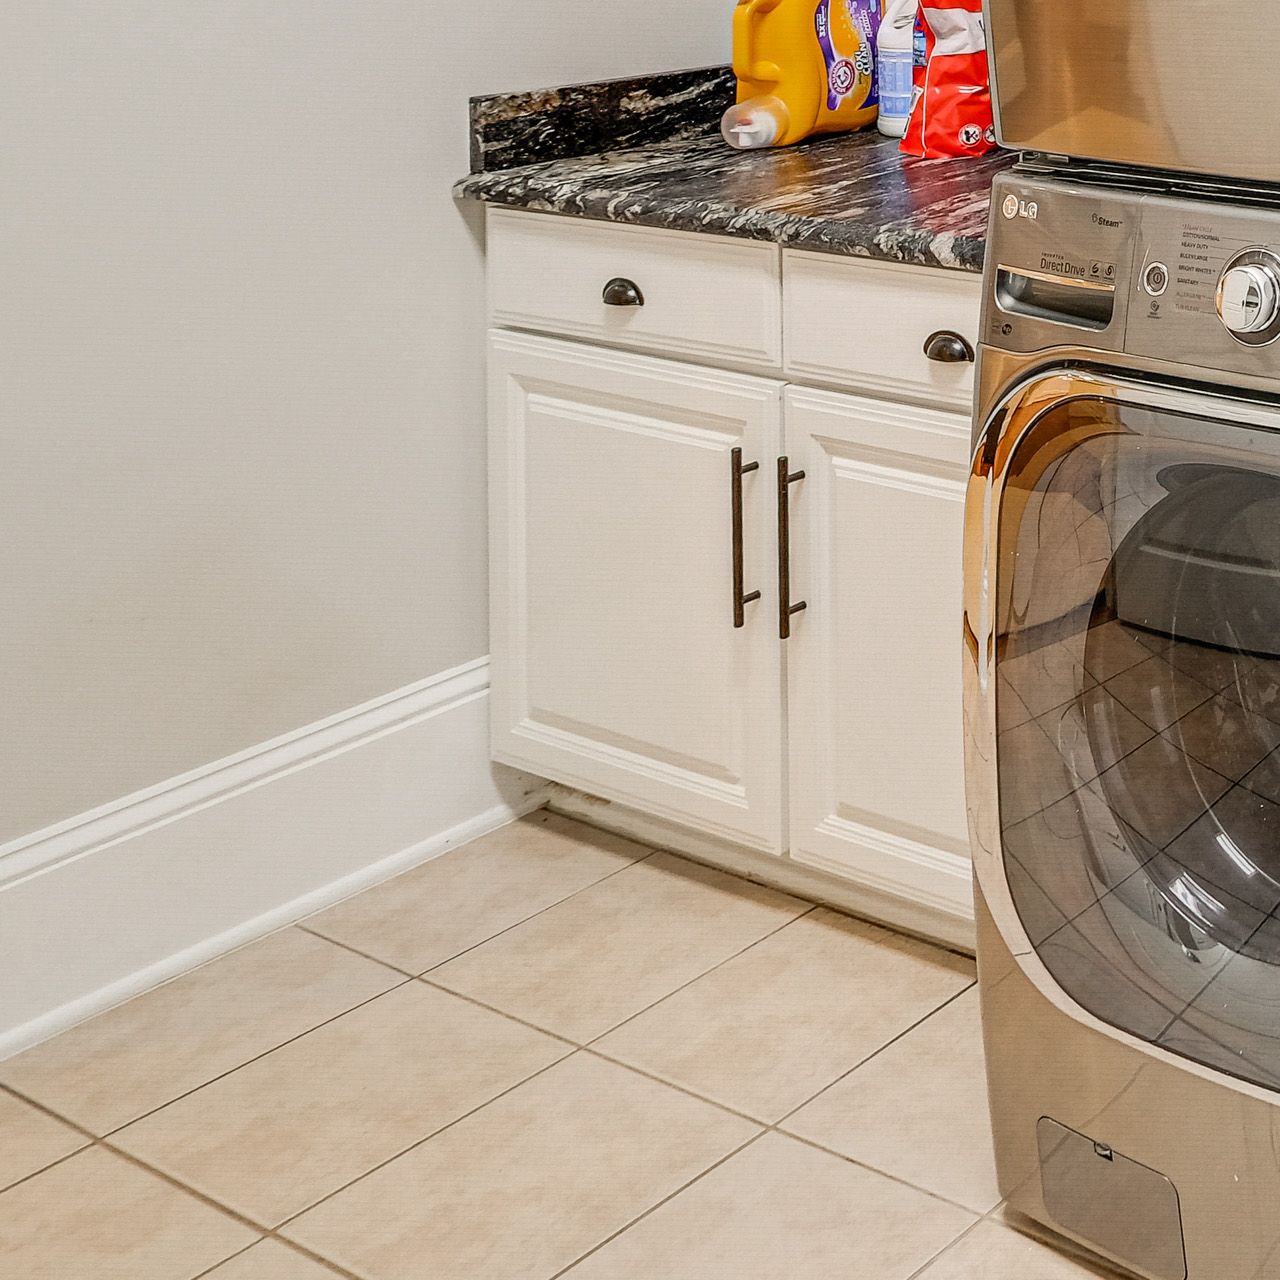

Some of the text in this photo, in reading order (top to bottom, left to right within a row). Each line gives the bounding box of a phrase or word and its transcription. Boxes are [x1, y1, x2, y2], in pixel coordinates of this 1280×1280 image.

[1019, 200, 1038, 219] LG
[1097, 216, 1120, 228] Steam
[1040, 257, 1086, 276] Direct Drive
